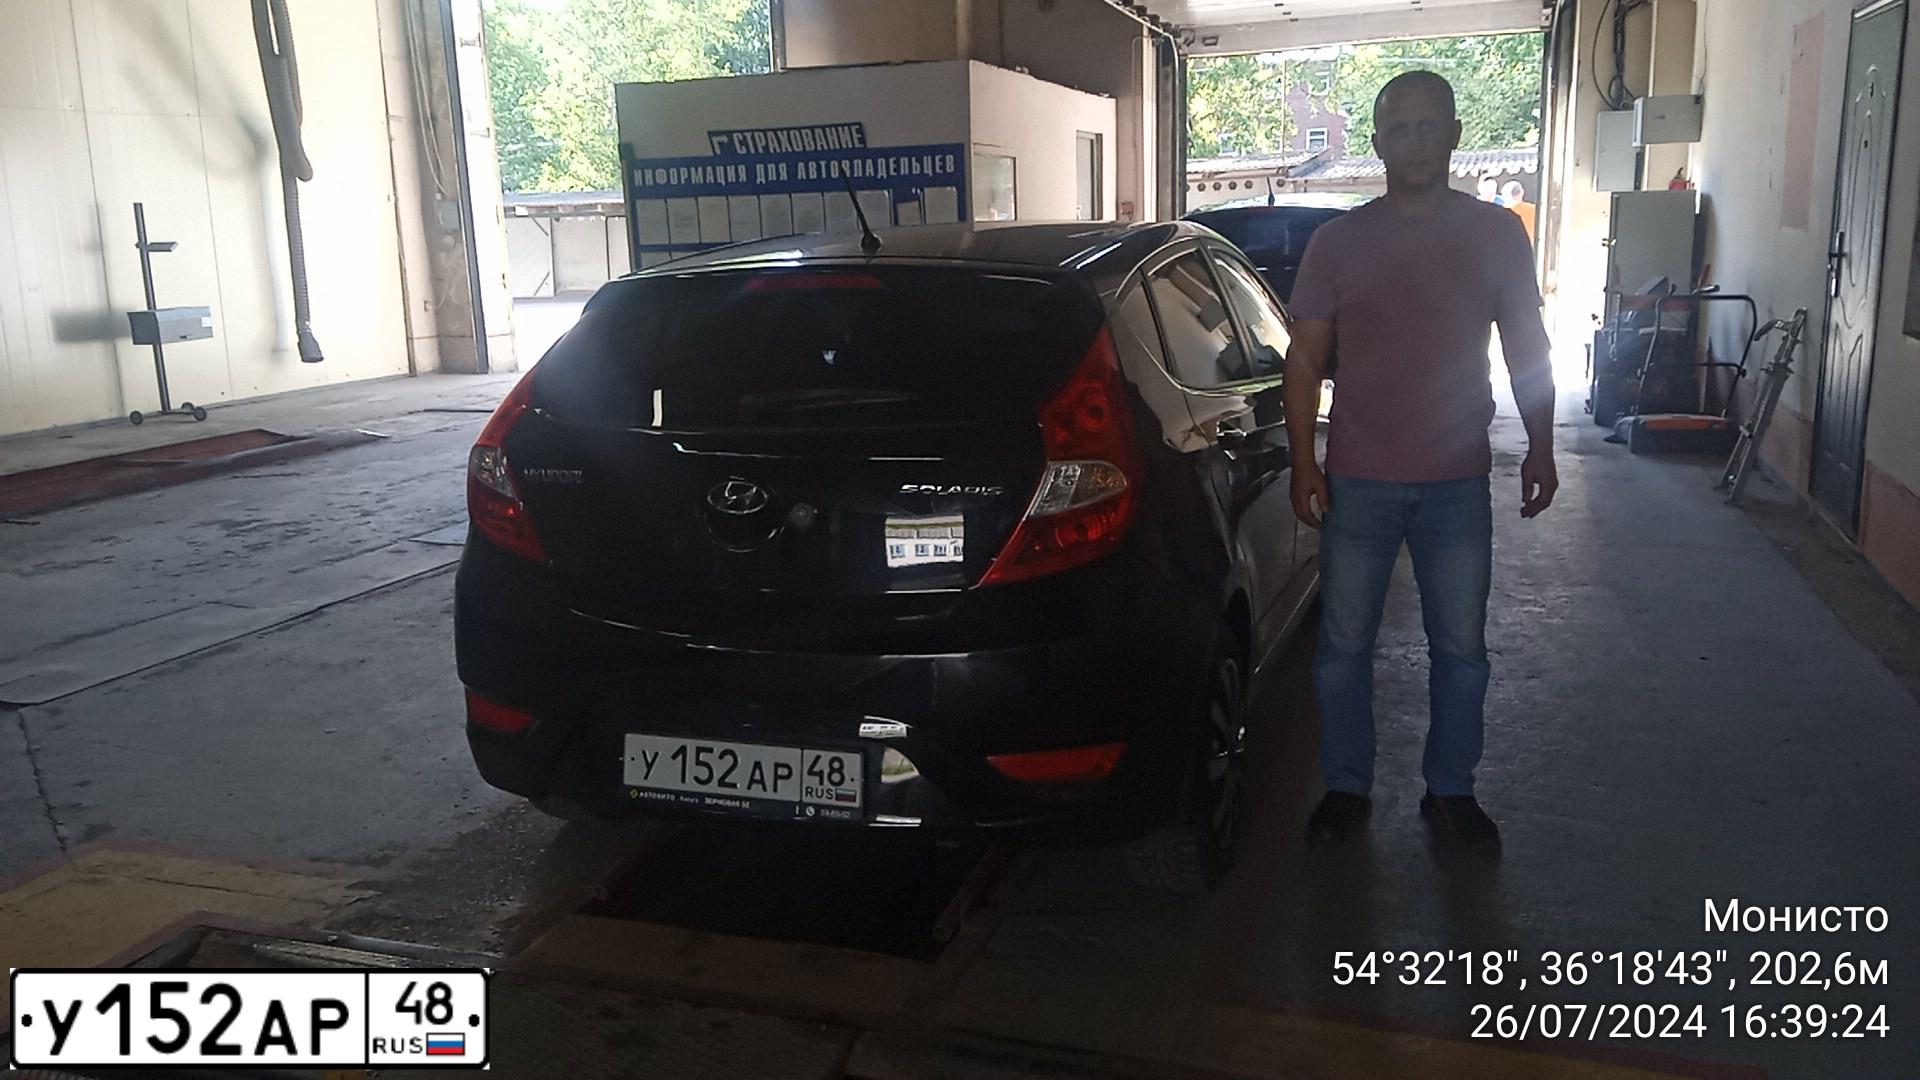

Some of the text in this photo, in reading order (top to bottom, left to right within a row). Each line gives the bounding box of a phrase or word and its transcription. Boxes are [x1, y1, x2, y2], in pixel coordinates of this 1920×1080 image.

[732, 124, 865, 155] СТРАХОВАНИЕ
[633, 163, 748, 188] ИНФОРМАЦИЯ
[755, 162, 788, 185] ДЛЯ
[807, 754, 846, 787] 48
[804, 785, 834, 801] RUS
